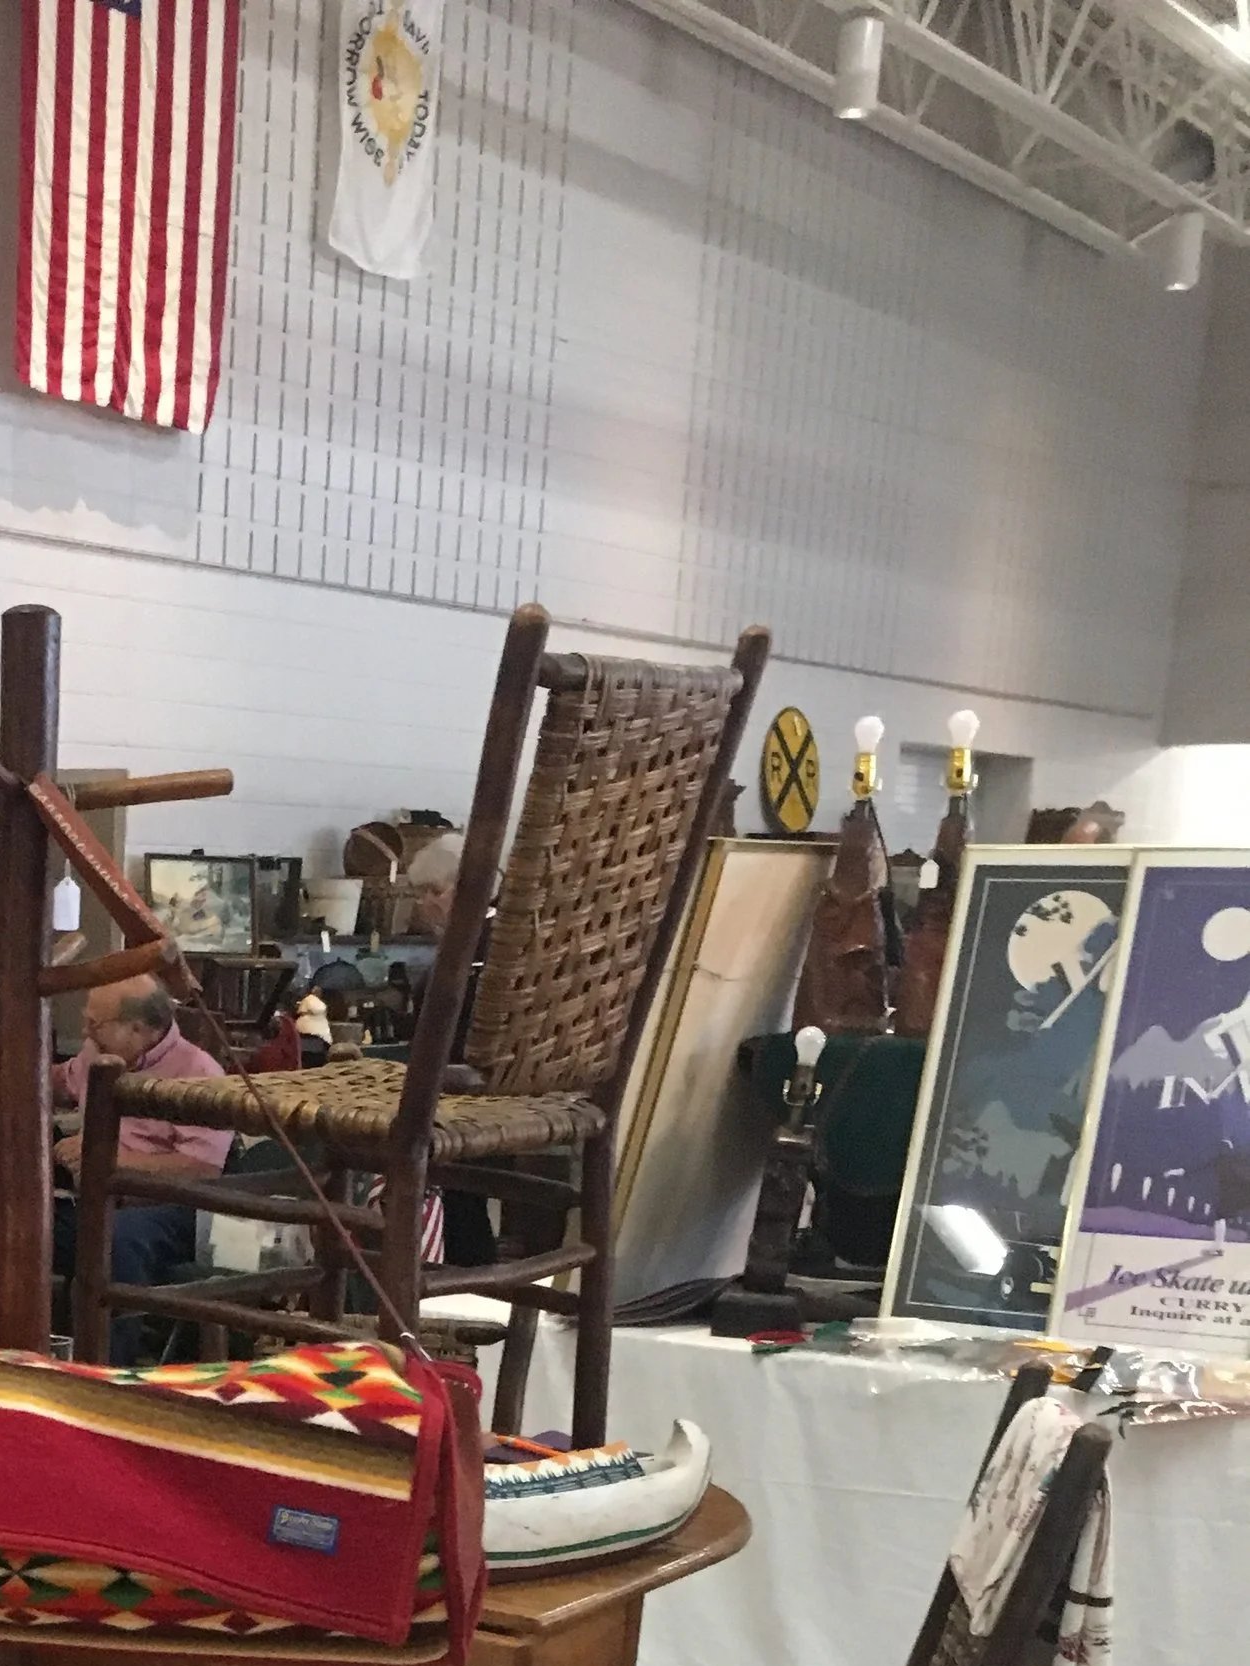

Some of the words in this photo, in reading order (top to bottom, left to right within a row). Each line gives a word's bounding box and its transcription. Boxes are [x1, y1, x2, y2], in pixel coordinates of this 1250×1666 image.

[406, 89, 430, 162] TODAY
[1108, 1264, 1148, 1288] Ice
[1151, 1266, 1225, 1294] Skate
[1129, 1304, 1207, 1321] Inquire
[1212, 1315, 1233, 1325] at
[1159, 1295, 1246, 1313] CURRY
